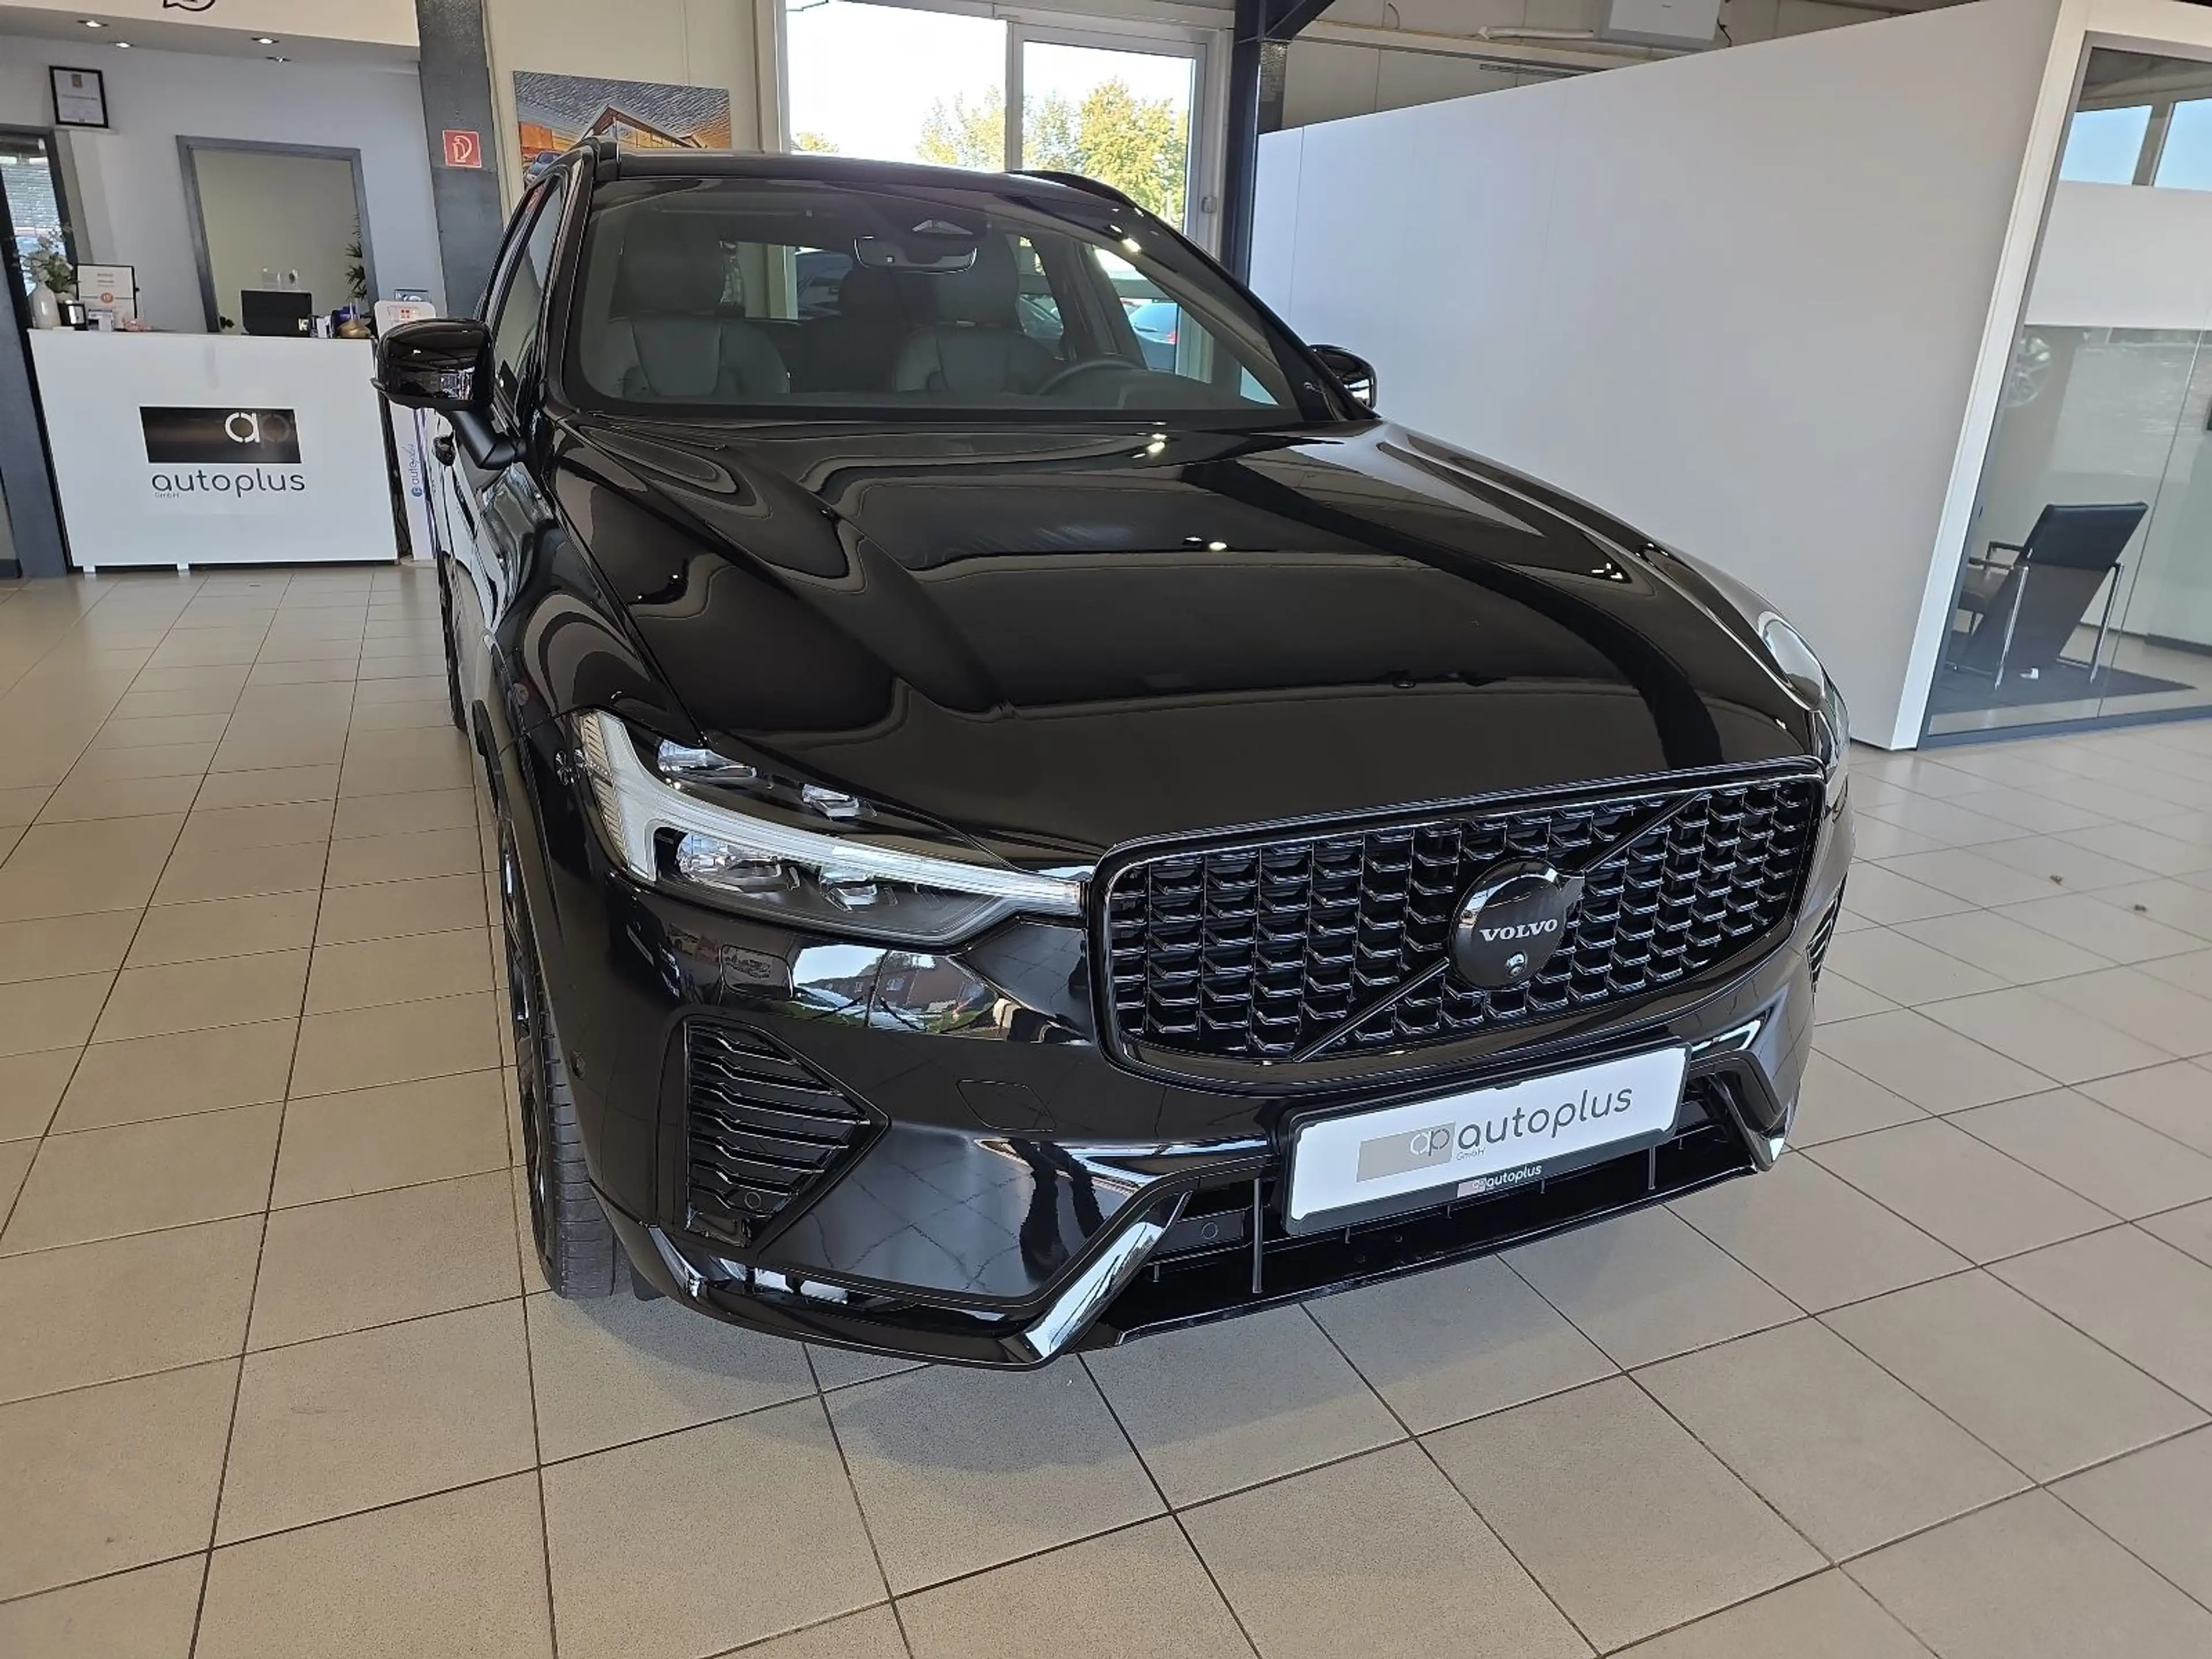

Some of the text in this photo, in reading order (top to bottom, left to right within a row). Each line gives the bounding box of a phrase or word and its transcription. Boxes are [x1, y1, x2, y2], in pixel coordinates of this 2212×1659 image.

[151, 467, 305, 498] autoplus
[1479, 919, 1558, 941] VOLVO
[1457, 1088, 1633, 1150] autoplus
[1456, 1147, 1486, 1161] GmbH
[1486, 1165, 1543, 1187] autoplus
